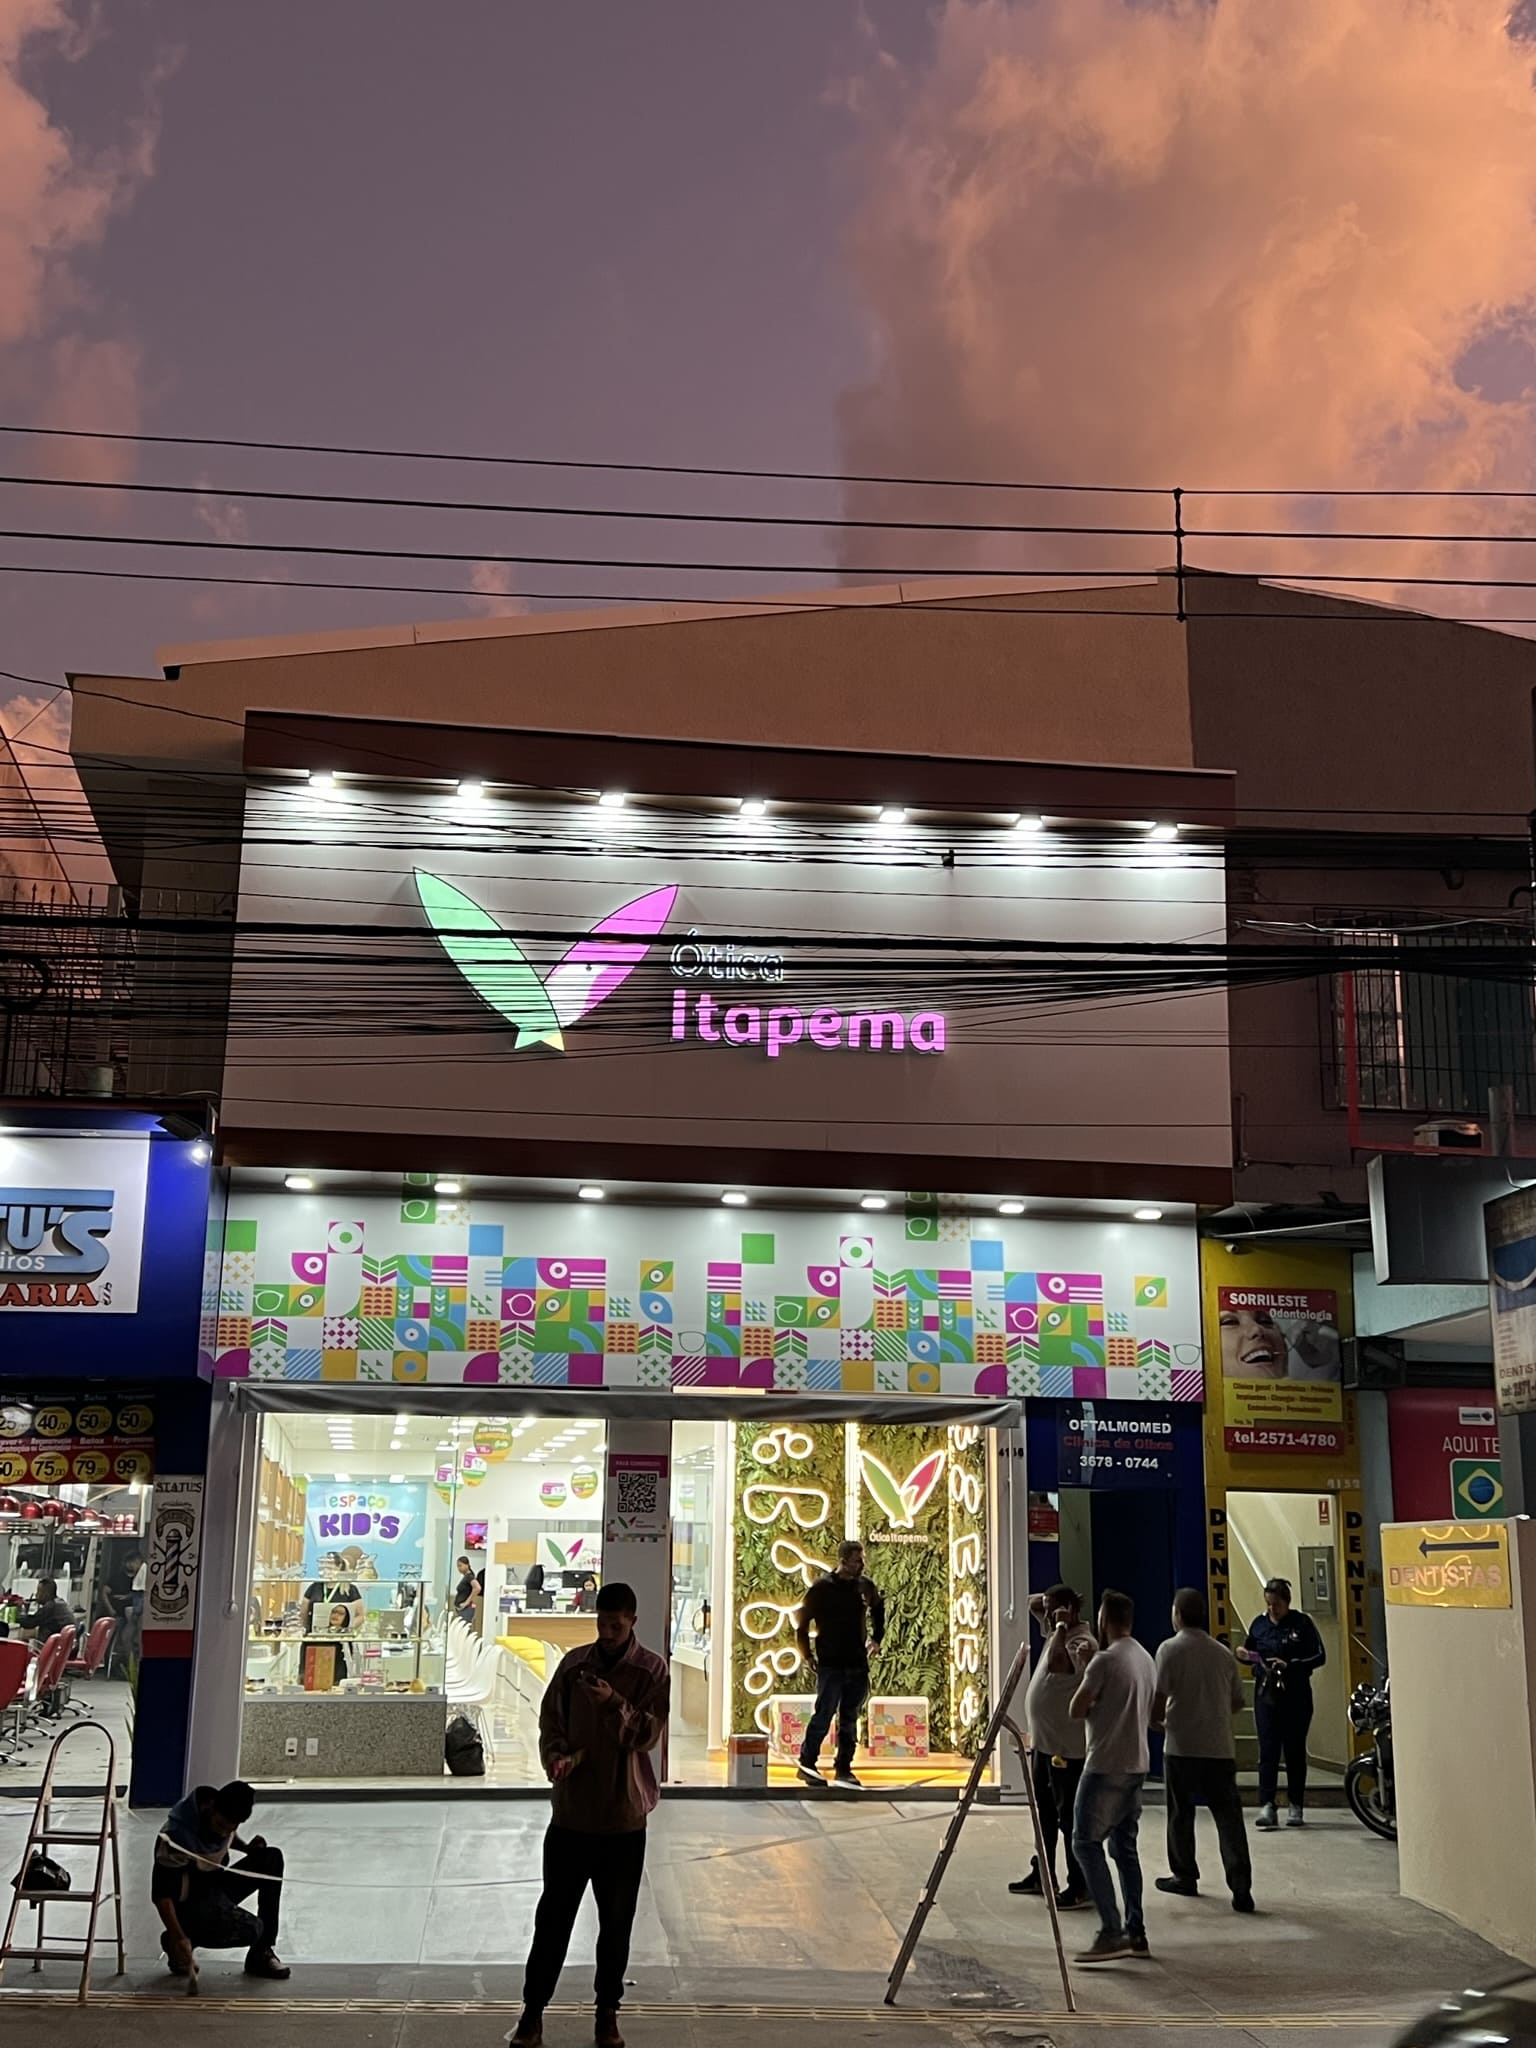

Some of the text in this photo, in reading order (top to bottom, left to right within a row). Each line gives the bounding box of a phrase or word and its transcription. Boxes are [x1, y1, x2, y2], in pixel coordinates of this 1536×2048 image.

[670, 928, 785, 982] Ótica
[671, 989, 946, 1058] Itapema
[1229, 1292, 1308, 1308] SORRILESTE
[1269, 1308, 1333, 1322] Odontologia
[1500, 1362, 1536, 1381] DENTIS
[1069, 1419, 1172, 1434] OFTALMOMED
[1234, 1431, 1337, 1447] tel.2571-4780
[1442, 1436, 1478, 1453] AQUI
[1079, 1456, 1113, 1468] 3678
[1125, 1457, 1159, 1470] 0744
[155, 1481, 202, 1493] STATUS
[329, 1494, 386, 1511] espaço
[319, 1512, 400, 1539] KID'S
[1389, 1564, 1501, 1589] DENTISTAS
